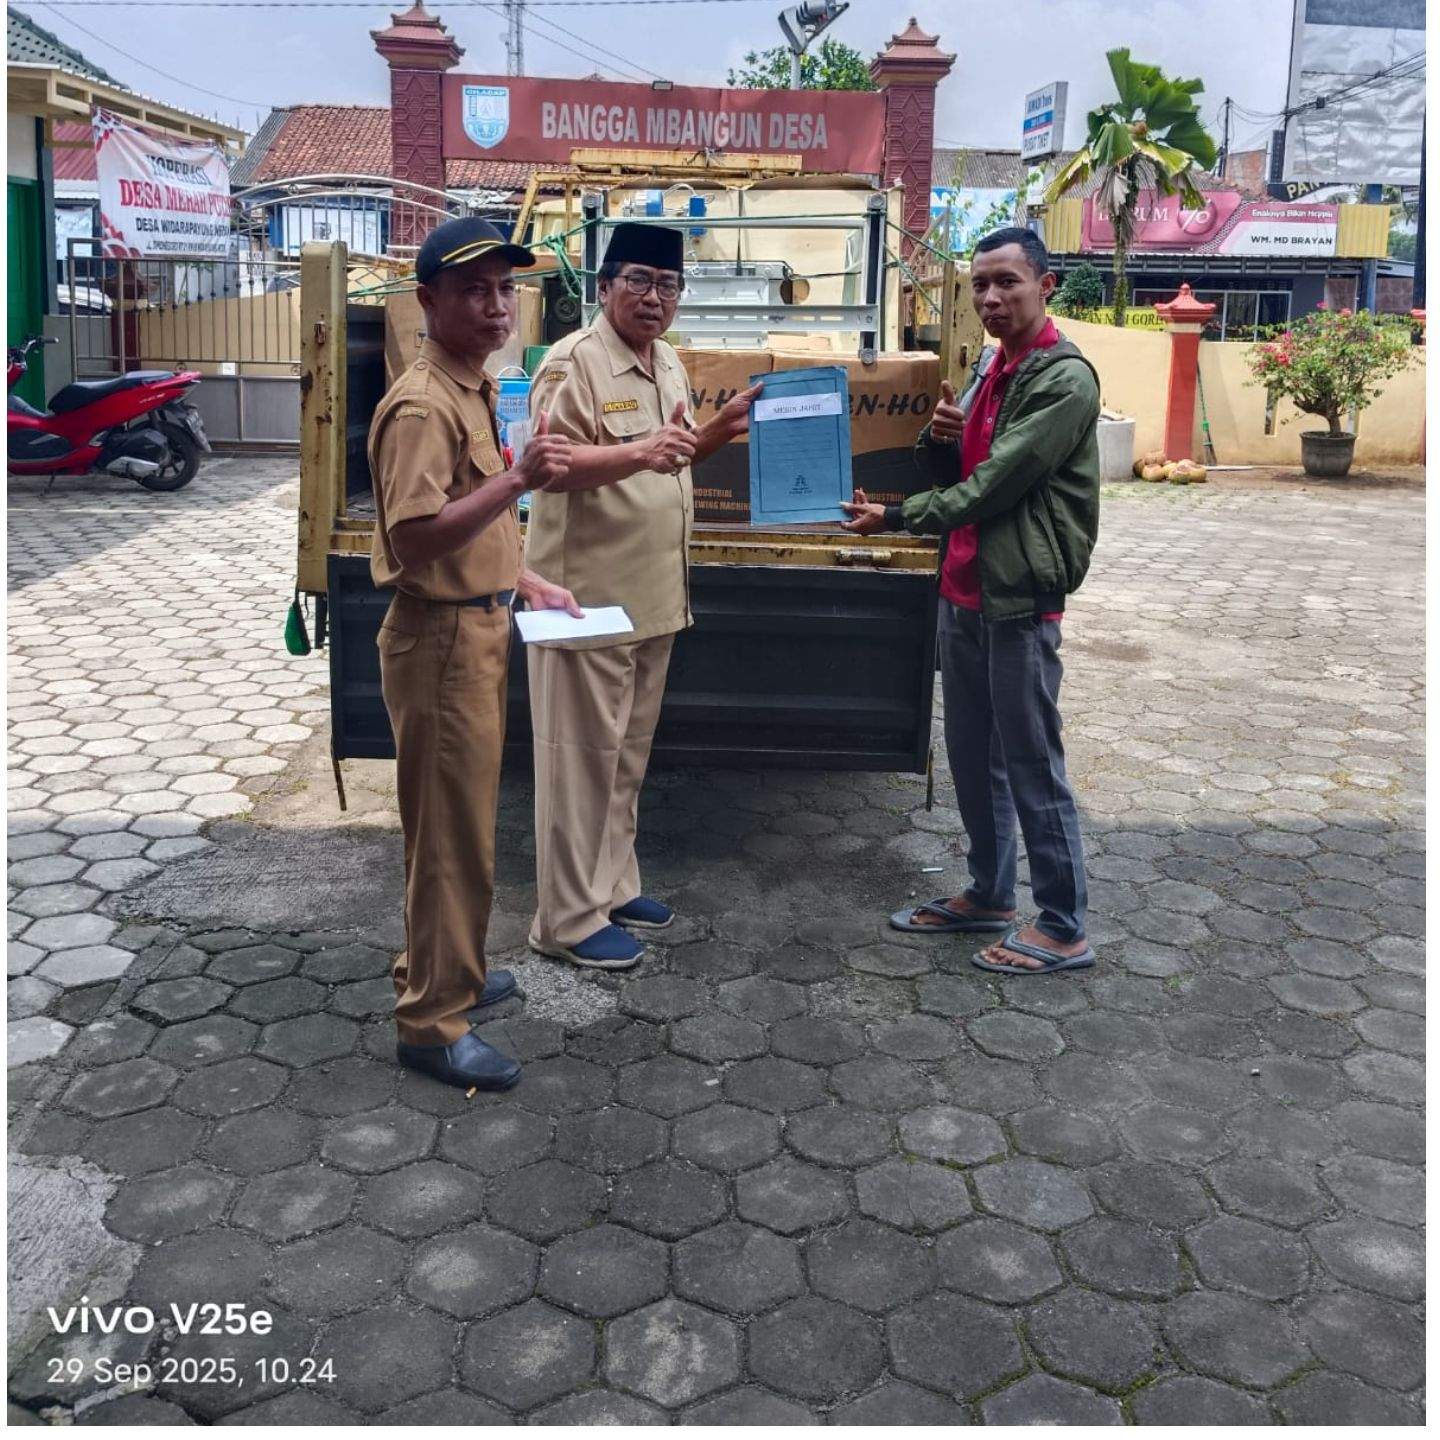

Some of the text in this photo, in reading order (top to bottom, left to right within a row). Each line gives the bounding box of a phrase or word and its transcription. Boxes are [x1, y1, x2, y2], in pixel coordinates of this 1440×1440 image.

[542, 102, 828, 150] BANGGA MBANGUN DESA
[119, 178, 162, 209] DESA
[164, 185, 207, 215] MERAH
[136, 217, 160, 233] DESA
[1274, 236, 1288, 244] MD
[1291, 236, 1332, 245] BRAYAN
[693, 487, 732, 498] NDUSTRIAL
[693, 500, 719, 509] EWING
